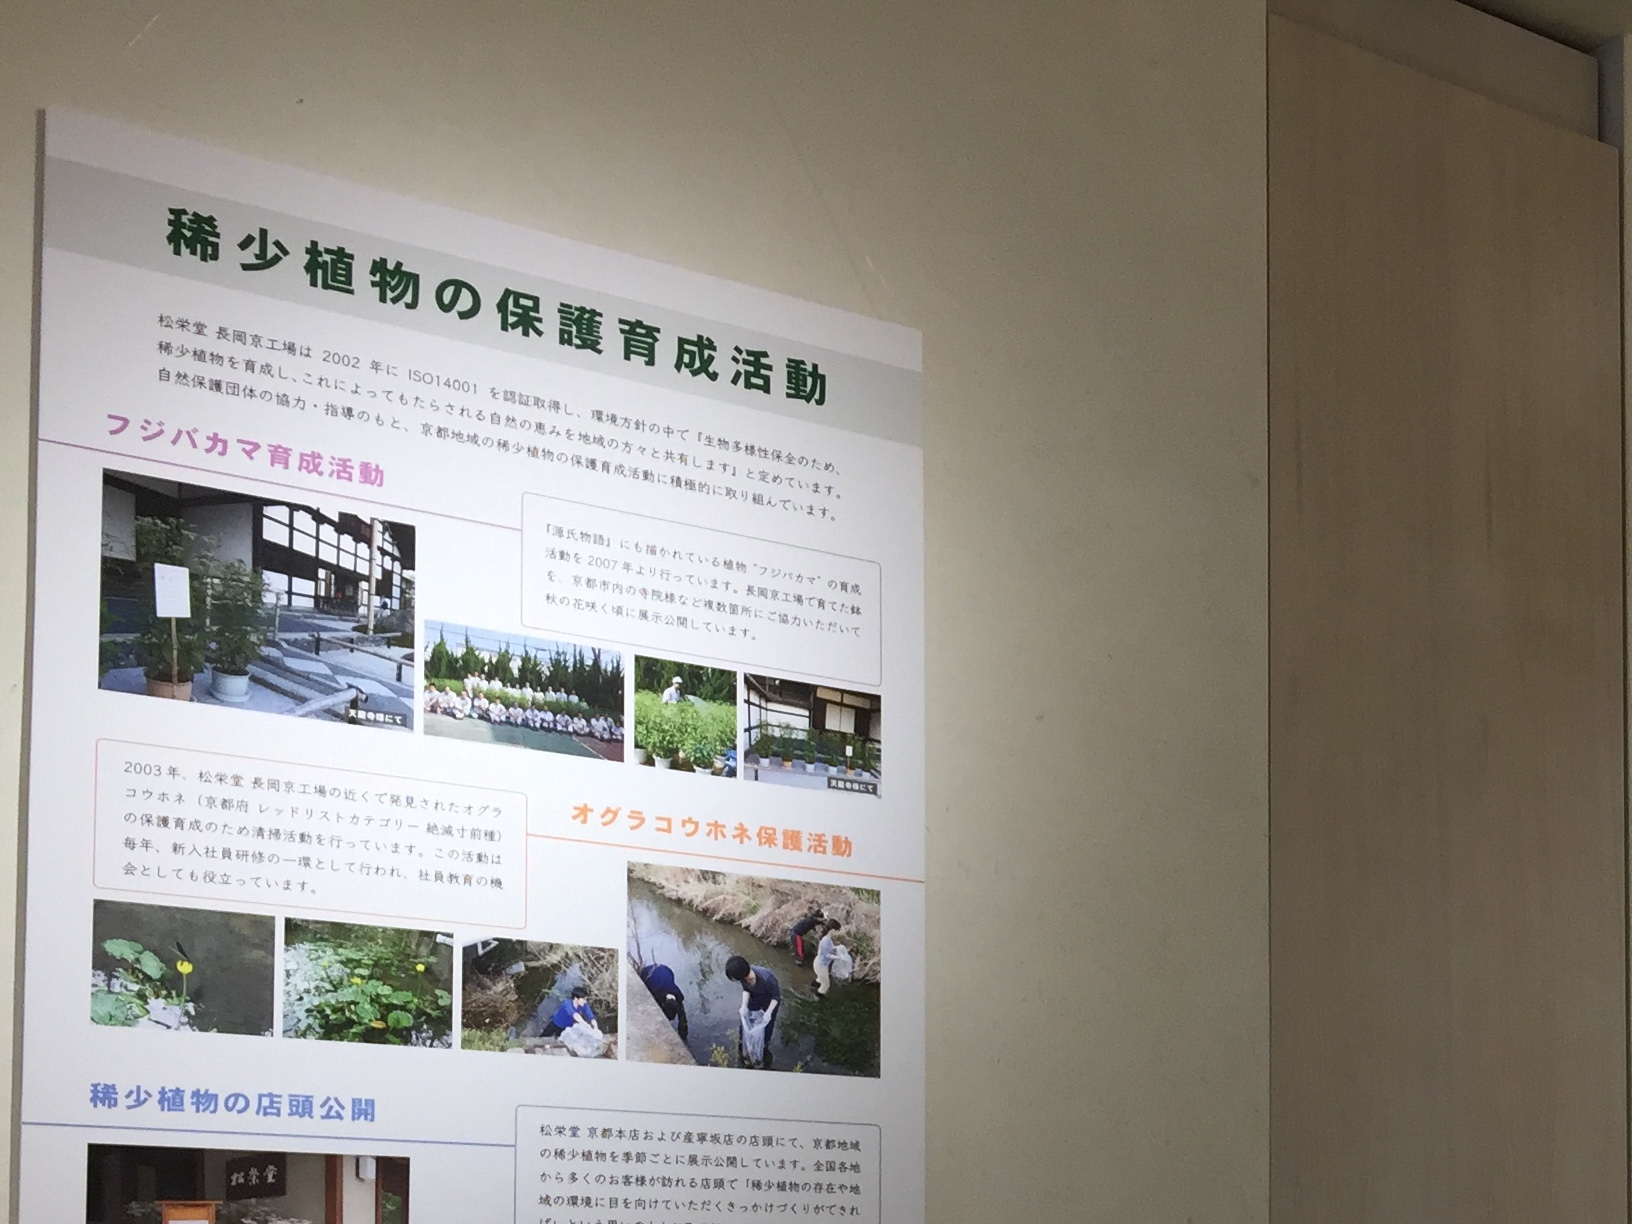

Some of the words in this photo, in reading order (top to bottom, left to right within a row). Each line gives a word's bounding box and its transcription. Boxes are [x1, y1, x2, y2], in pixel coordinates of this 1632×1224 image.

[166, 206, 828, 406] 稀少植物の保護育成活動
[157, 313, 208, 337] 松栄堂
[216, 326, 313, 358] 長岡京工場は
[322, 349, 361, 370] 2002
[369, 359, 399, 376] 年に
[407, 369, 479, 395] ISO14001
[107, 414, 384, 487] フジバカマ育成活動
[571, 803, 854, 858] オグラコウホネ保護活動
[123, 862, 317, 895] 会としても役立っています。
[89, 1082, 376, 1123] 稀少植物の店頭公開
